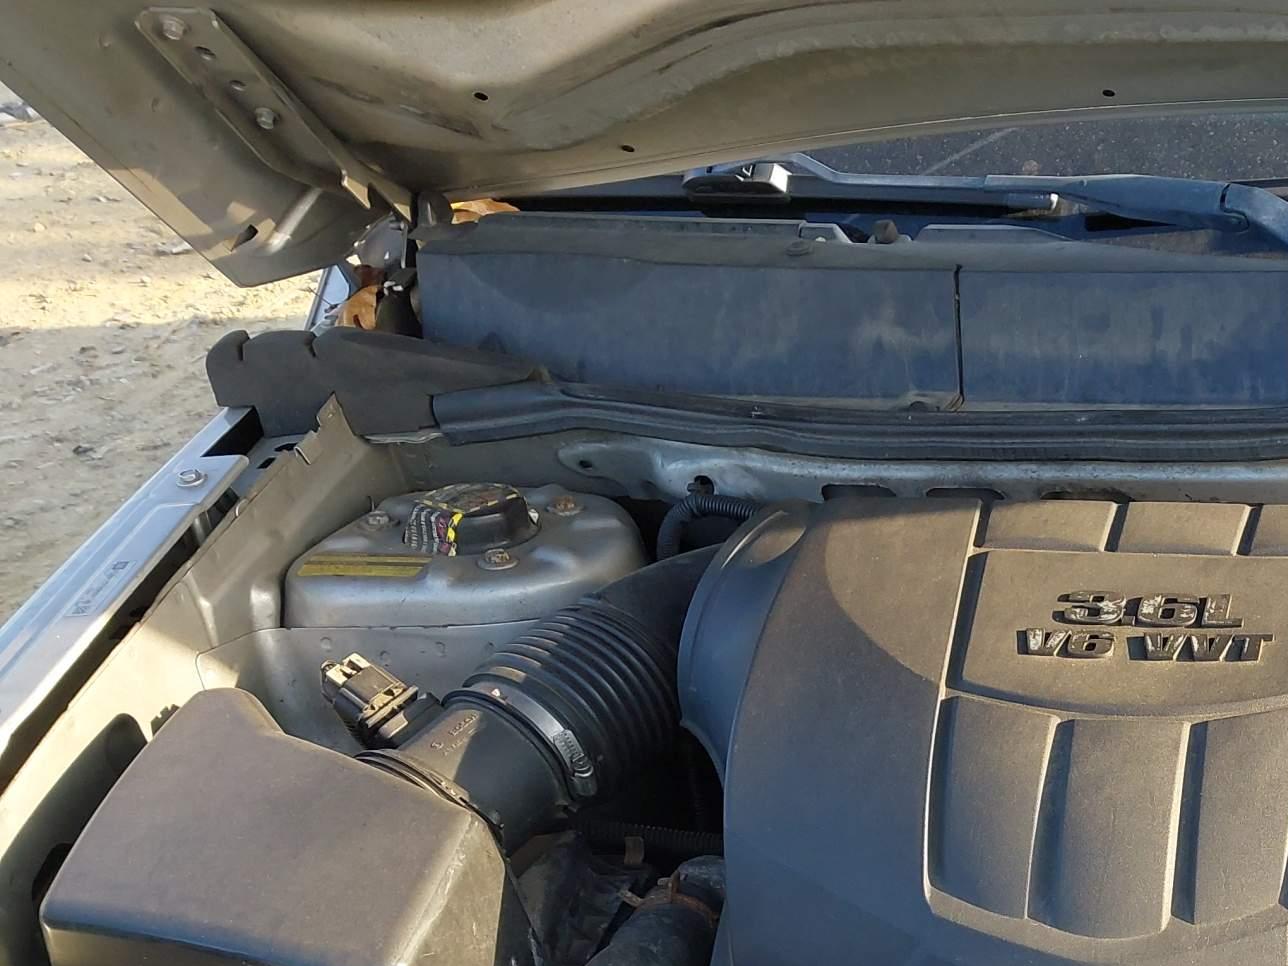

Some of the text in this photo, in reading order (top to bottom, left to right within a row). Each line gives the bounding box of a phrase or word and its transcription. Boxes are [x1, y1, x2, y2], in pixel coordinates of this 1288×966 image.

[1051, 590, 1245, 628] 3.6L
[1016, 627, 1275, 662] V6 VVT
